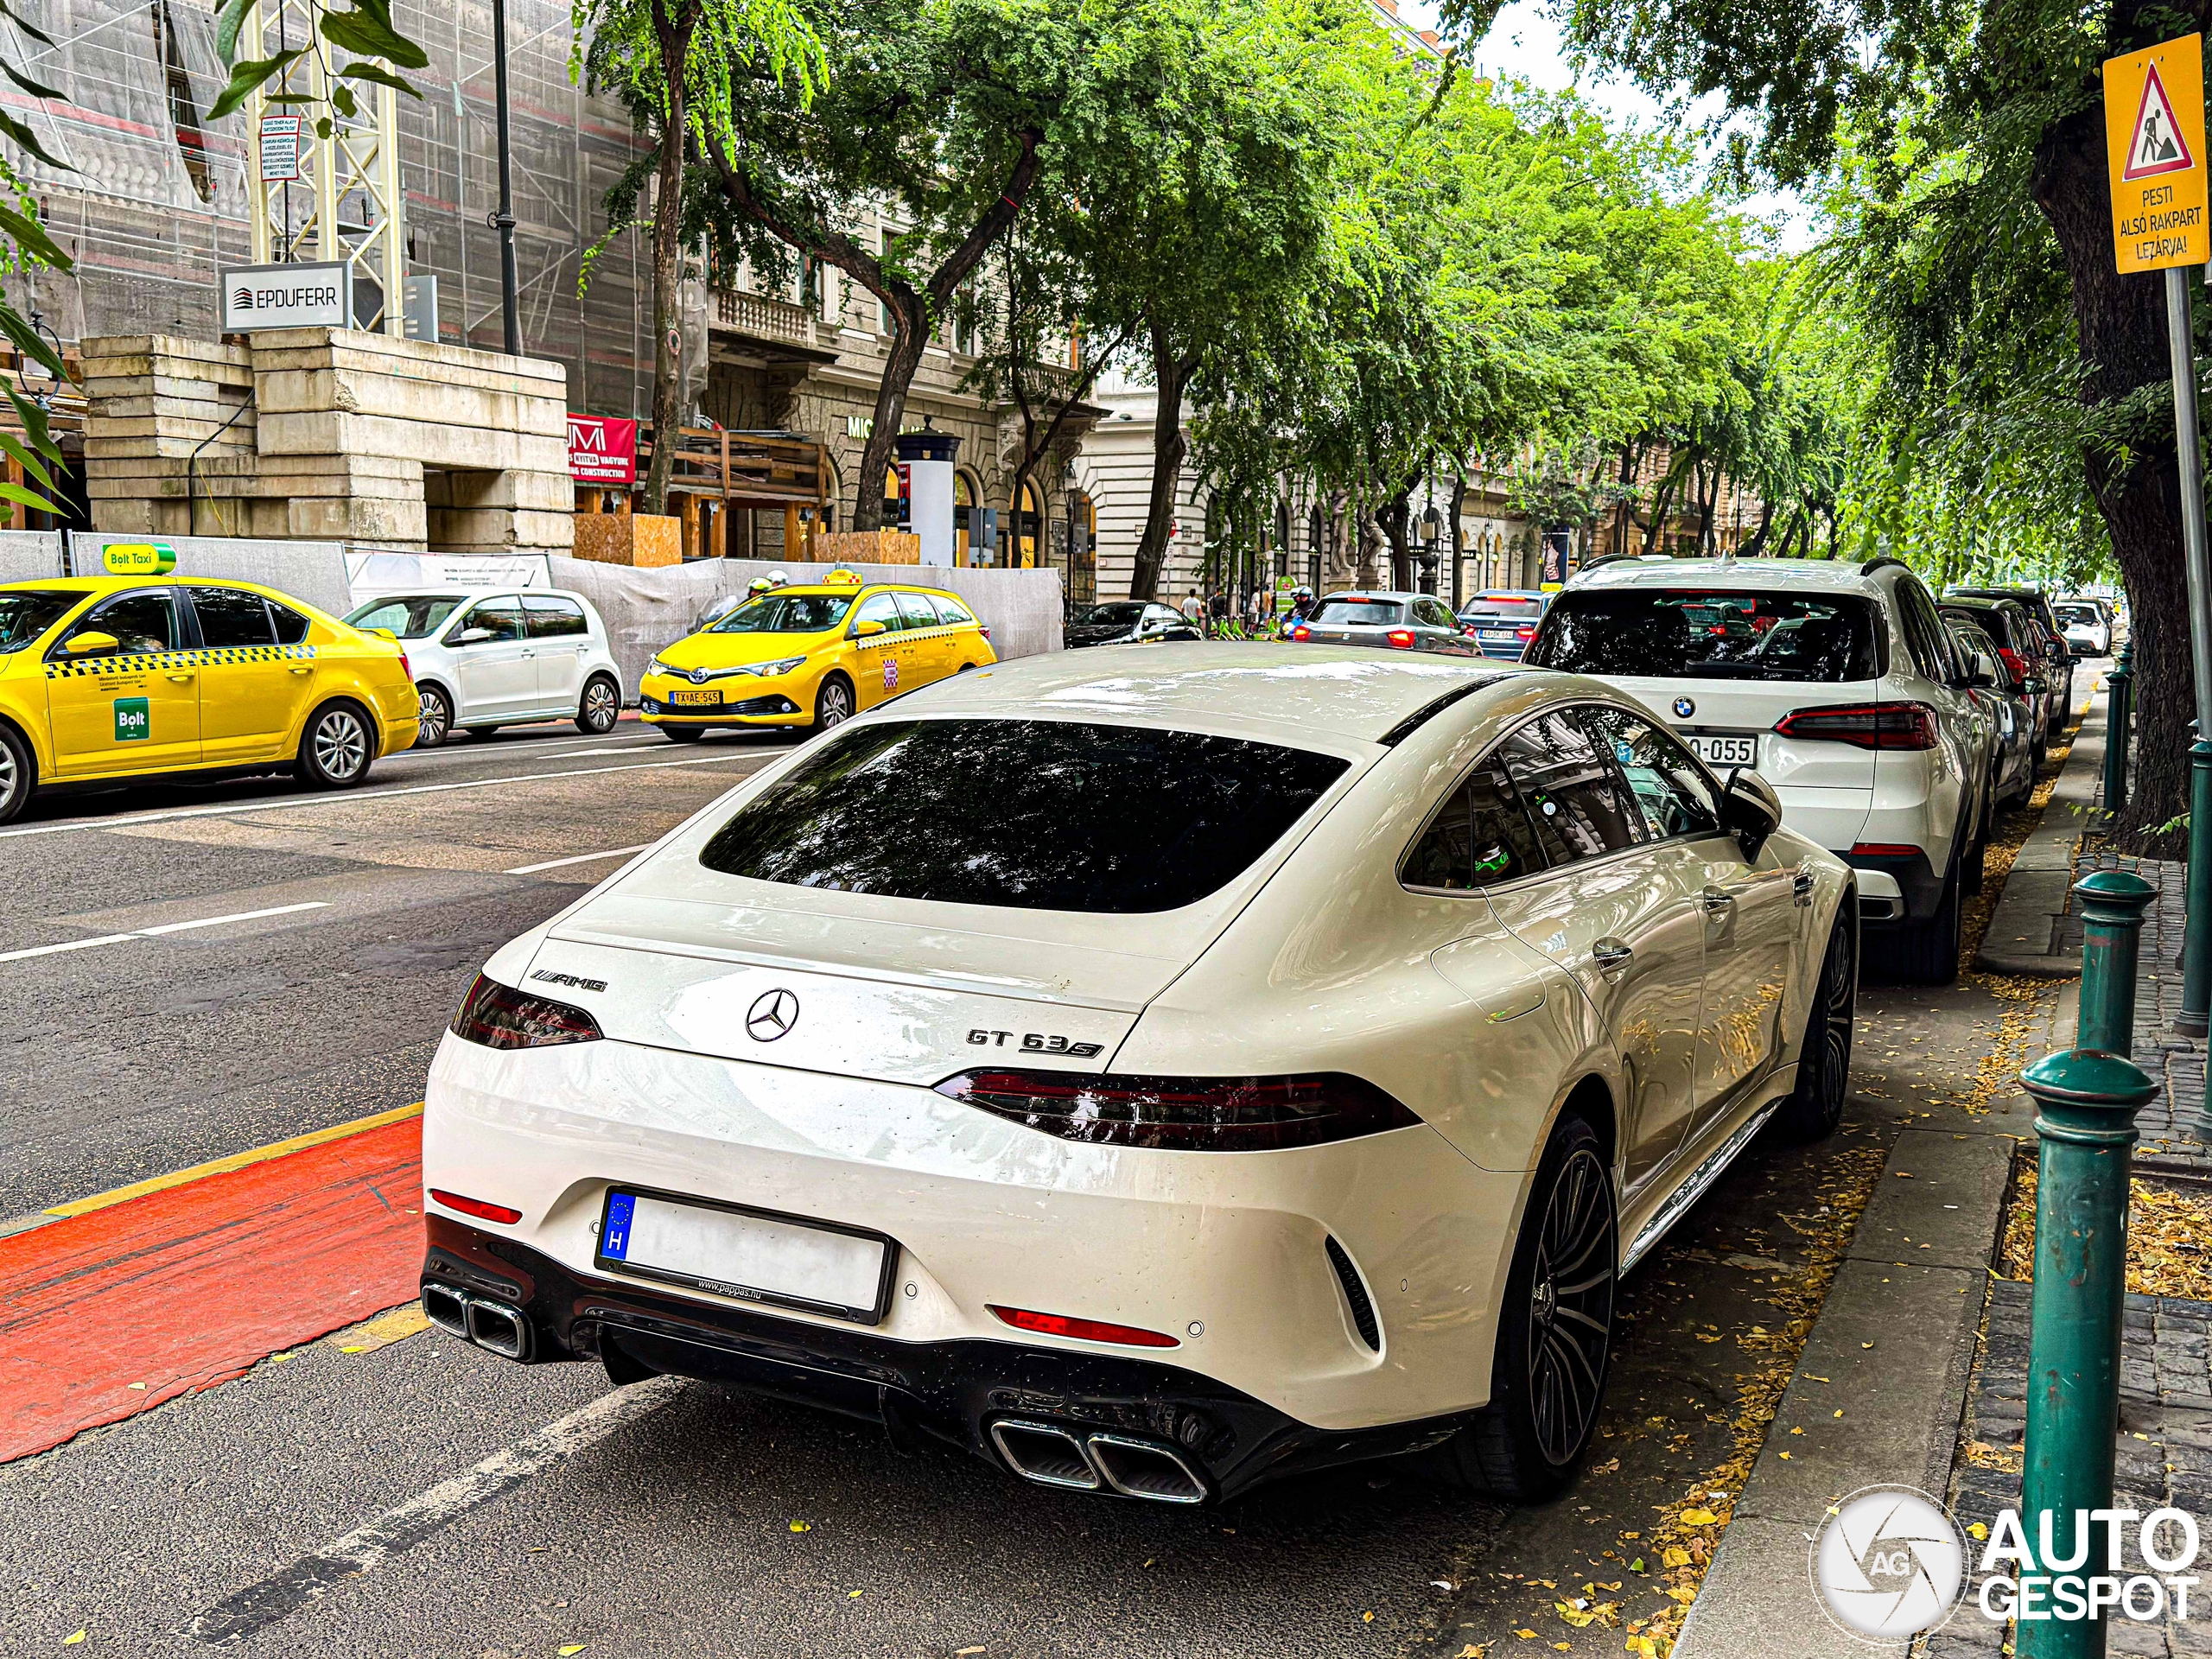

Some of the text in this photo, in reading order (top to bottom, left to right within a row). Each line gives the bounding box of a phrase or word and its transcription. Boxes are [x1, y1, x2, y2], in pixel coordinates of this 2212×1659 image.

[2143, 186, 2172, 207] PESTI
[2120, 207, 2201, 237] ALSÓ RAKPART
[2136, 235, 2187, 259] LEZÁRVA!
[257, 287, 337, 308] EPDUFERR
[575, 454, 597, 463] NYITVA
[580, 467, 626, 478] CONSTRUCTION
[111, 552, 151, 567] Bolt Taxi
[118, 711, 145, 731] Bolt
[550, 973, 608, 992] AMG
[966, 1029, 1014, 1046] GT
[608, 1230, 622, 1250] H
